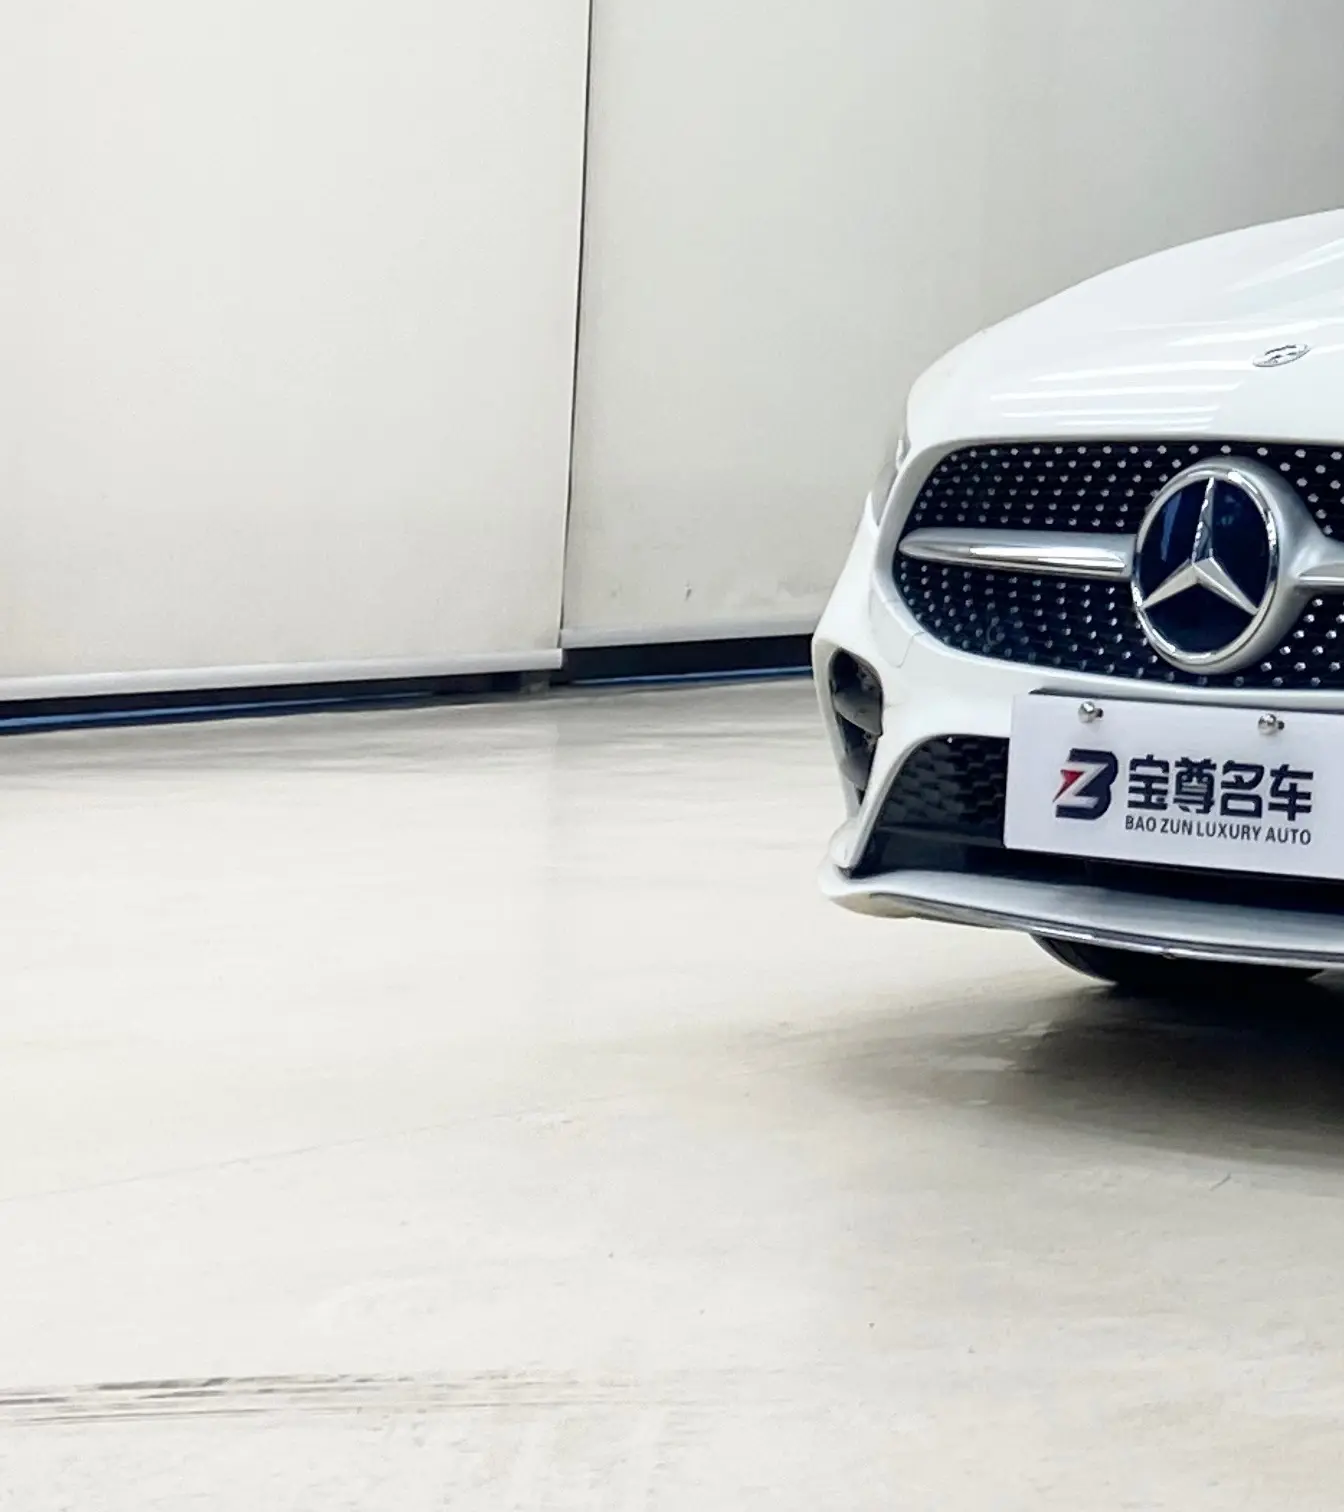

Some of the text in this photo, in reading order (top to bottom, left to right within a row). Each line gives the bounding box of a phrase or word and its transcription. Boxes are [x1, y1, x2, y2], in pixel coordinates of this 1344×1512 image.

[1127, 753, 1314, 822] 宝尊名车
[1125, 814, 1312, 846] BAO ZUN LUXURY AUTO
